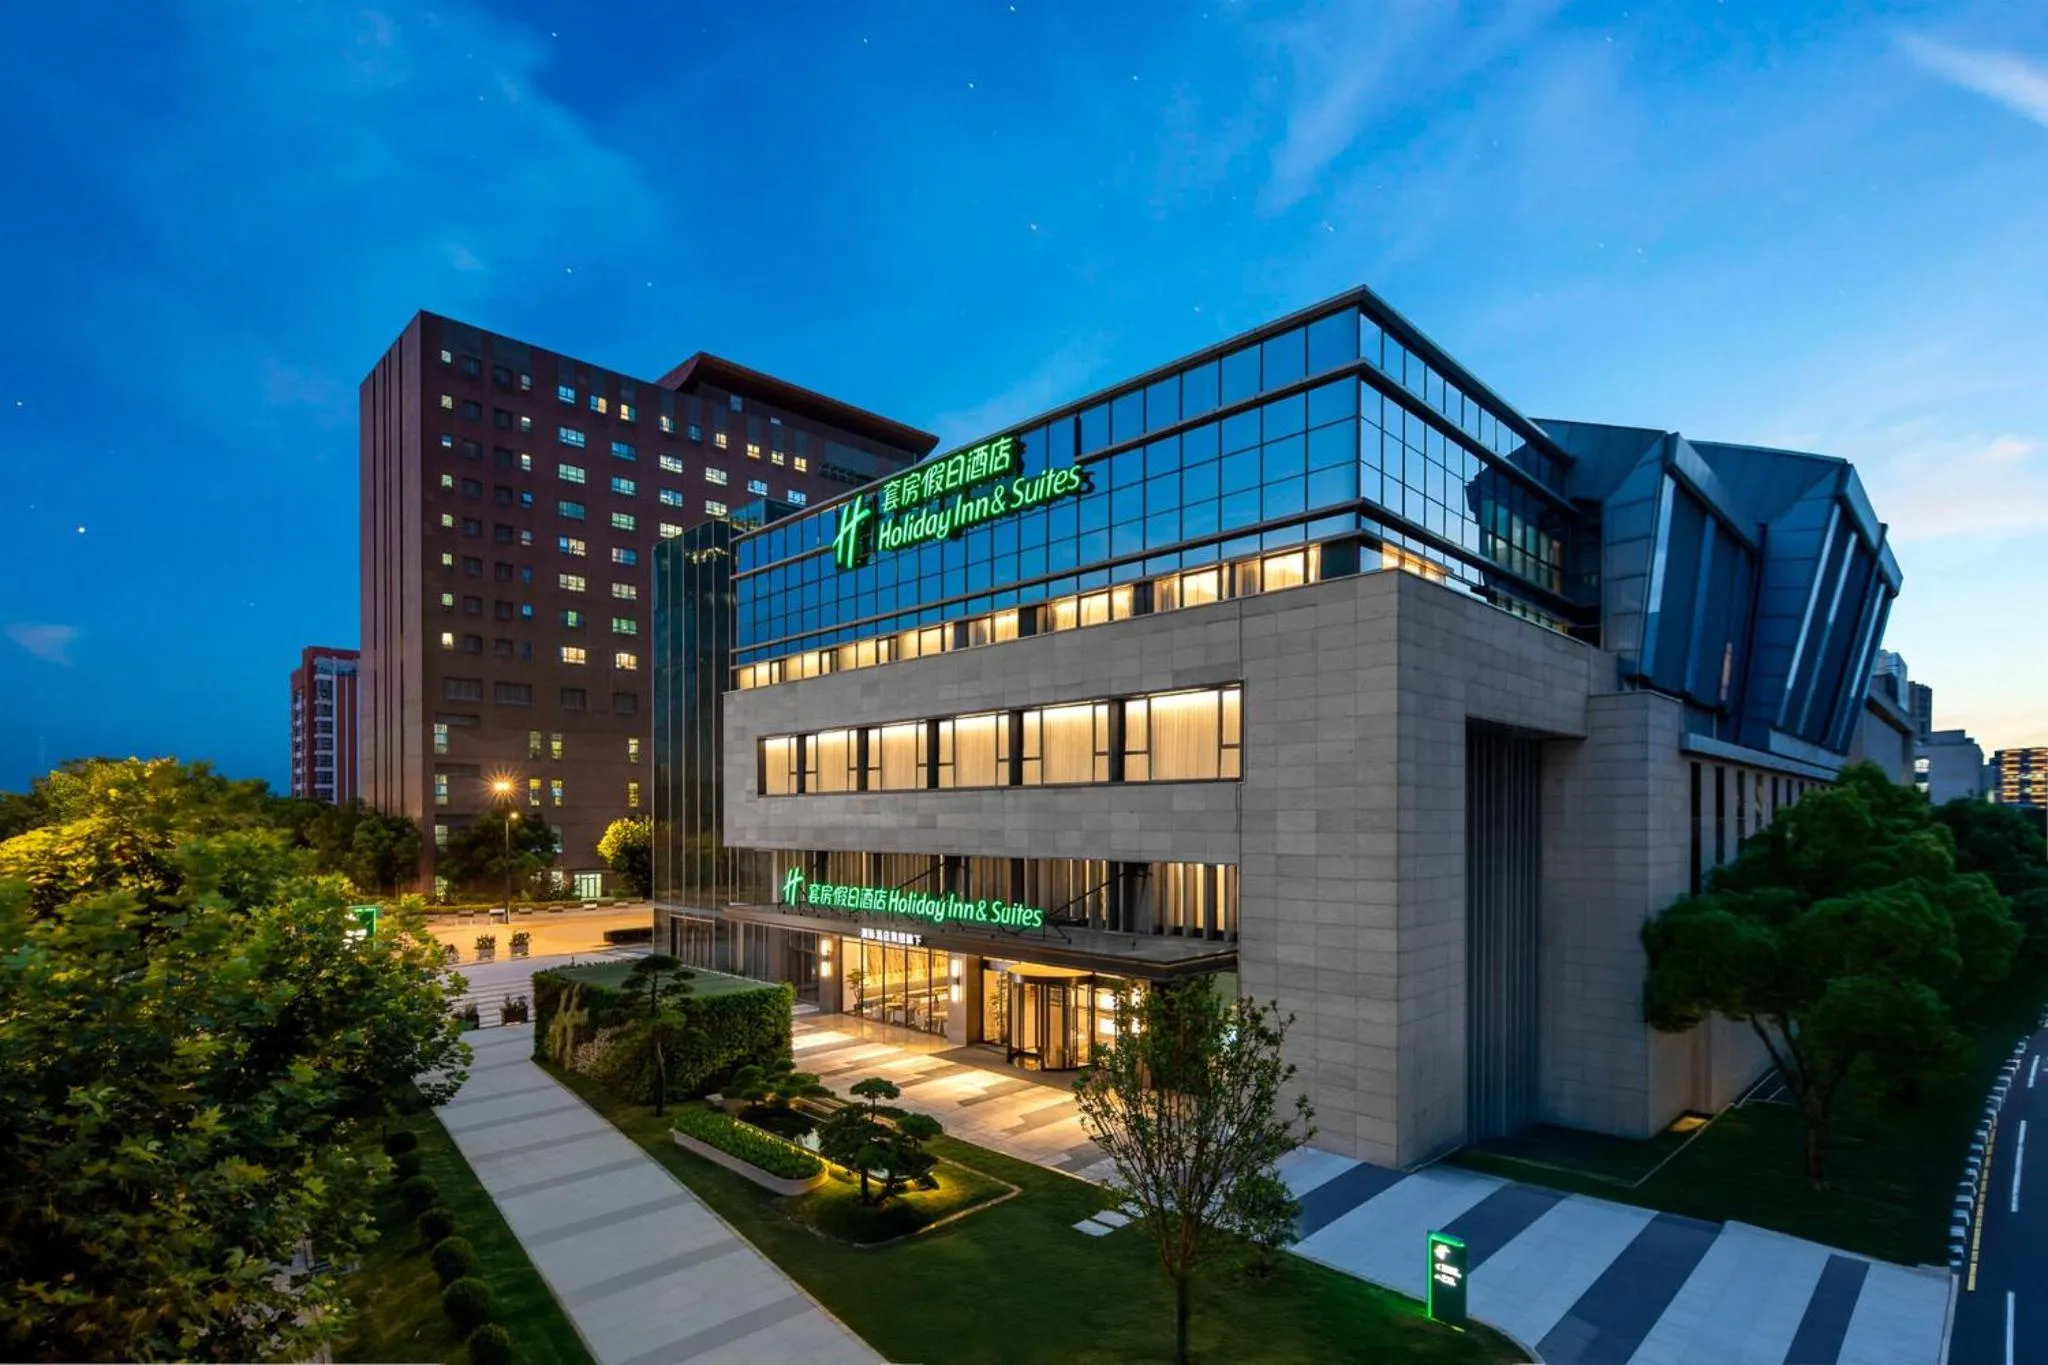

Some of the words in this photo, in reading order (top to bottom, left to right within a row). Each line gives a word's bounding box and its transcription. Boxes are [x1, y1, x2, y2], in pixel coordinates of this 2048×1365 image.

[883, 437, 1012, 512] 套房假日酒店
[879, 508, 951, 550] Holiday
[954, 494, 988, 526] Inn
[990, 484, 1006, 513] &
[1012, 464, 1081, 508] Suites
[808, 883, 888, 910] 套房假日酒店
[889, 890, 944, 922] Holiday
[949, 894, 975, 920] Inn
[978, 900, 988, 921] &
[990, 901, 1043, 928] Suites
